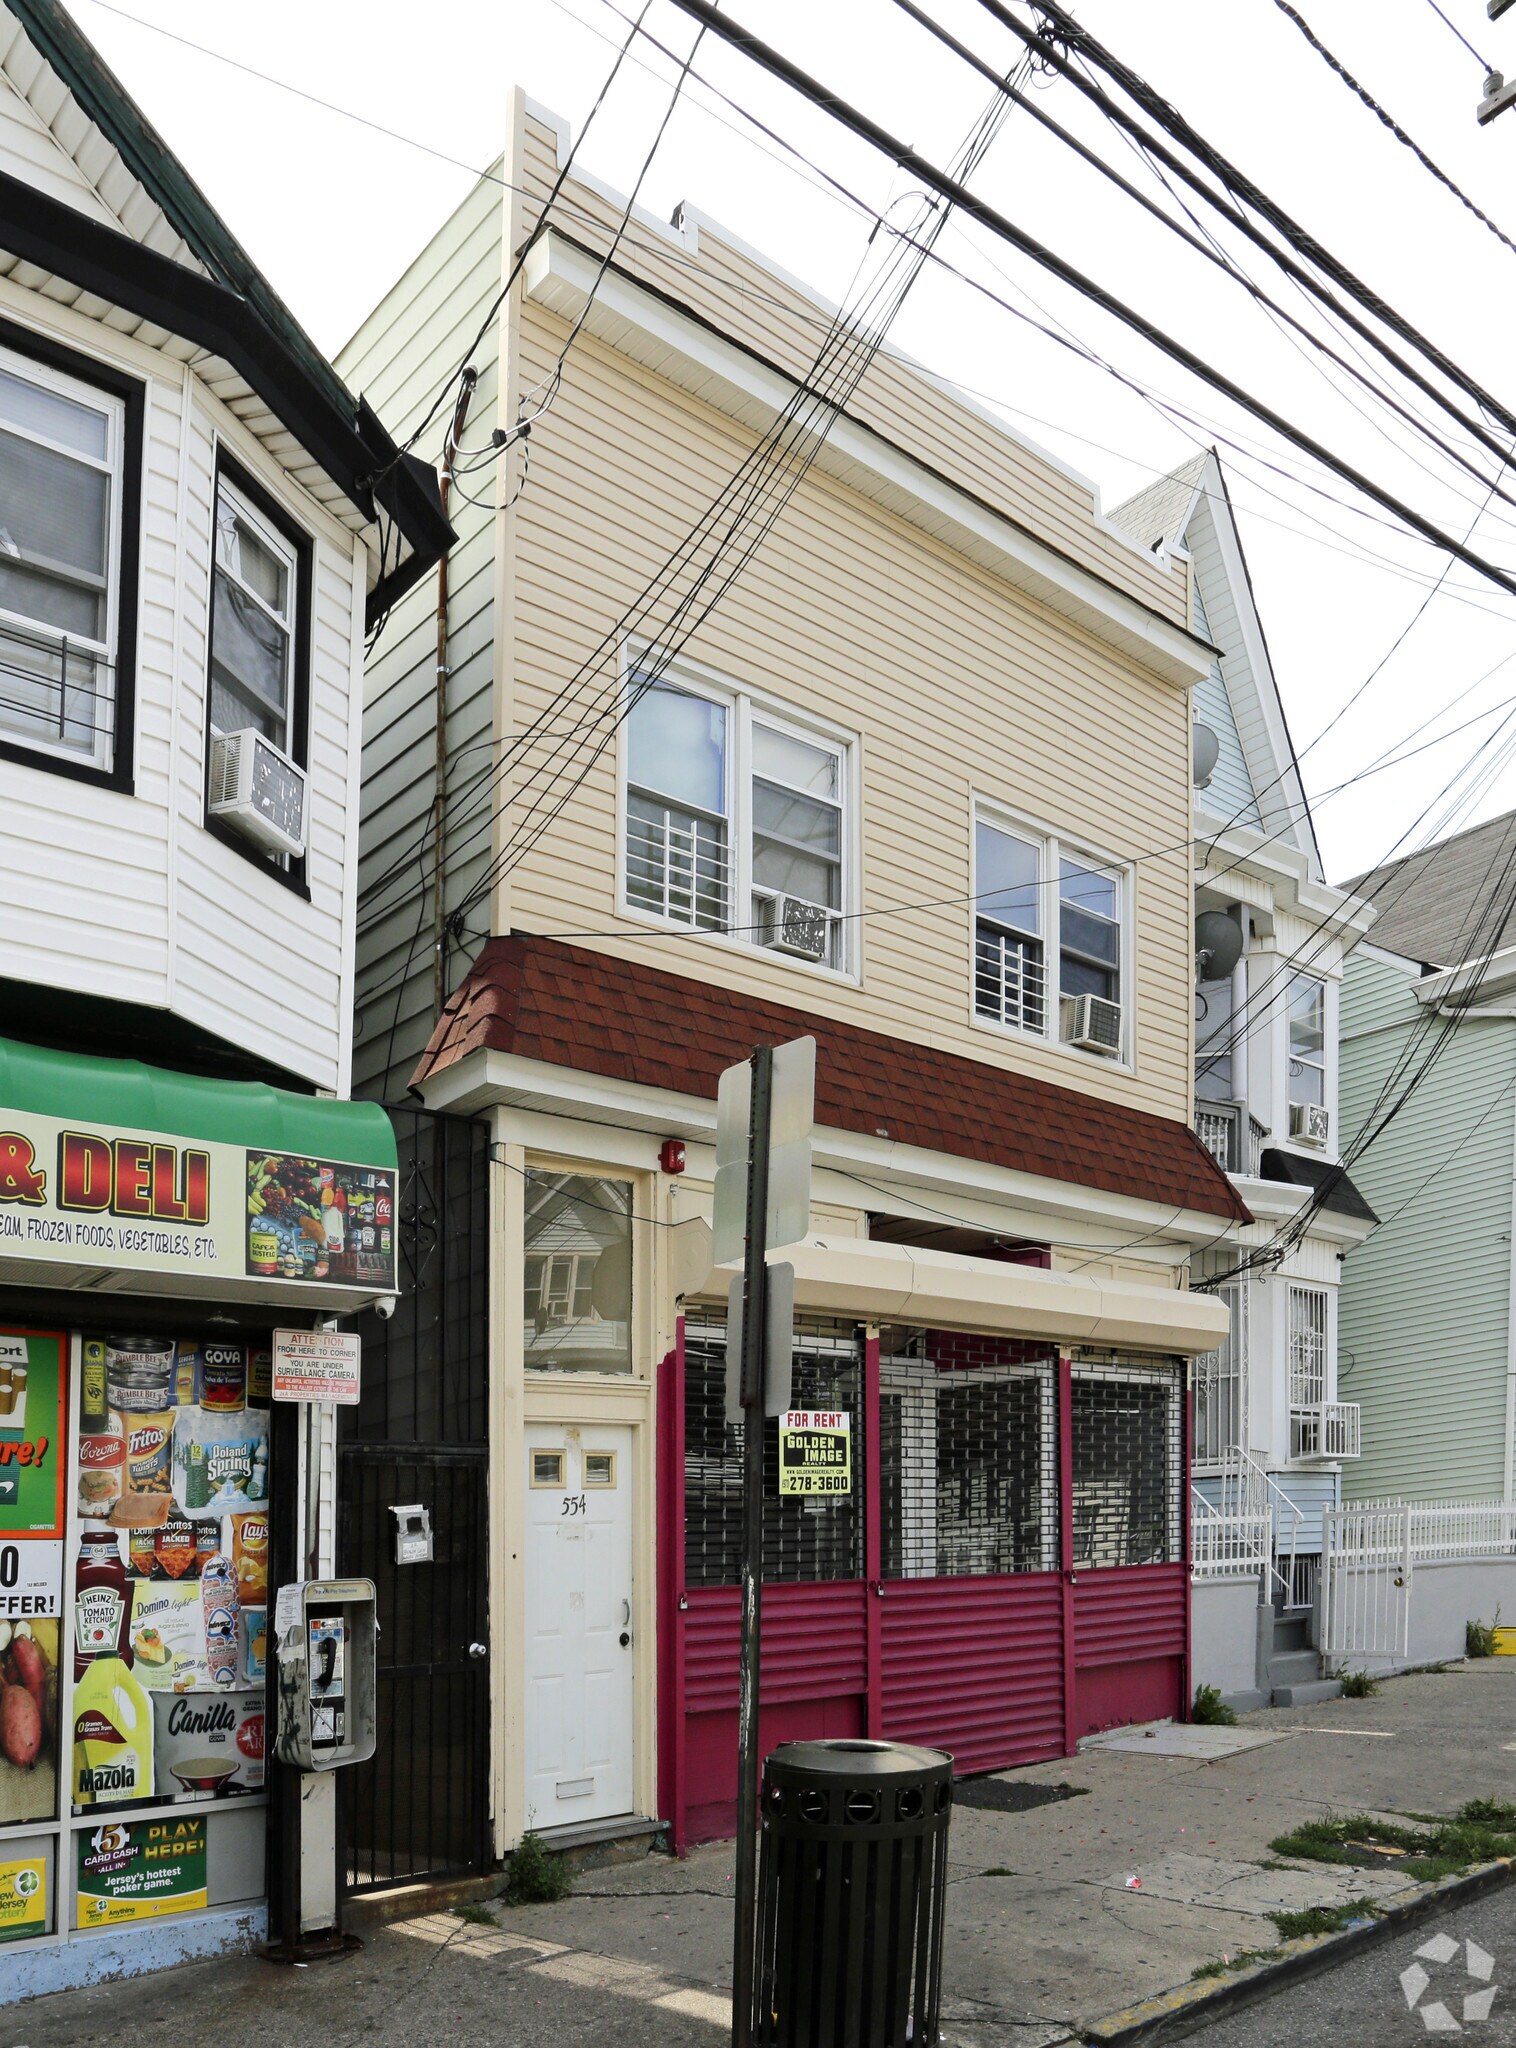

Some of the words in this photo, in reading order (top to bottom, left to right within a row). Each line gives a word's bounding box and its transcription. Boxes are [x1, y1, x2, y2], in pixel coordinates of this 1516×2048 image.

[0, 1131, 47, 1207] &
[57, 1130, 211, 1226] DELI
[28, 1218, 72, 1244] FROZEN
[76, 1224, 116, 1251] FOODS,
[119, 1229, 192, 1258] VEGETABLES,
[195, 1237, 217, 1259] ETC.
[290, 1334, 344, 1347] ATTETION
[116, 1353, 144, 1363] BUMBLE
[145, 1353, 157, 1362] BEE
[205, 1349, 240, 1364] GOYA
[277, 1345, 296, 1353] FROM
[298, 1347, 316, 1355] HERE
[330, 1349, 356, 1357] CORNER
[216, 1375, 223, 1383] de
[277, 1367, 326, 1378] SURVEILLANCE
[328, 1370, 355, 1379] CAMERA
[116, 1390, 144, 1399] BUMBLE
[145, 1390, 157, 1398] BEE
[787, 1412, 808, 1427] FOR
[814, 1413, 842, 1428] RENT
[129, 1428, 165, 1455] Fritos
[787, 1435, 835, 1449] GOLDEN
[0, 1436, 48, 1468] re!
[79, 1440, 121, 1461] Corona
[192, 1445, 201, 1454] 12
[212, 1443, 248, 1460] Poland
[805, 1448, 843, 1462] IMAGE
[132, 1457, 159, 1472] TWISTS
[207, 1456, 252, 1481] Spring
[790, 1476, 848, 1491] 278-3600
[561, 1494, 587, 1516] 554
[160, 1520, 193, 1530] Doritos
[161, 1535, 190, 1543] JACKED
[0, 1545, 19, 1588] 0
[86, 1594, 112, 1604] HEINZ
[82, 1607, 115, 1617] TOMATO
[136, 1599, 169, 1617] Domino
[170, 1597, 192, 1612] light
[84, 1615, 114, 1624] KETCHUP
[174, 1659, 196, 1671] Domino
[197, 1660, 208, 1670] lig
[168, 1698, 238, 1736] Canilla
[77, 1722, 85, 1733] 0
[79, 1765, 136, 1792] Mazola
[99, 1823, 123, 1852] 5
[149, 1821, 199, 1841] PLAY
[84, 1853, 111, 1866] CARD
[112, 1846, 139, 1859] CASH
[145, 1839, 204, 1861] HERE!
[105, 1872, 144, 1887] Jersey's
[146, 1866, 182, 1880] hottest
[112, 1882, 142, 1896] poker
[144, 1878, 173, 1891] game.
[109, 1907, 136, 1916] Anything
